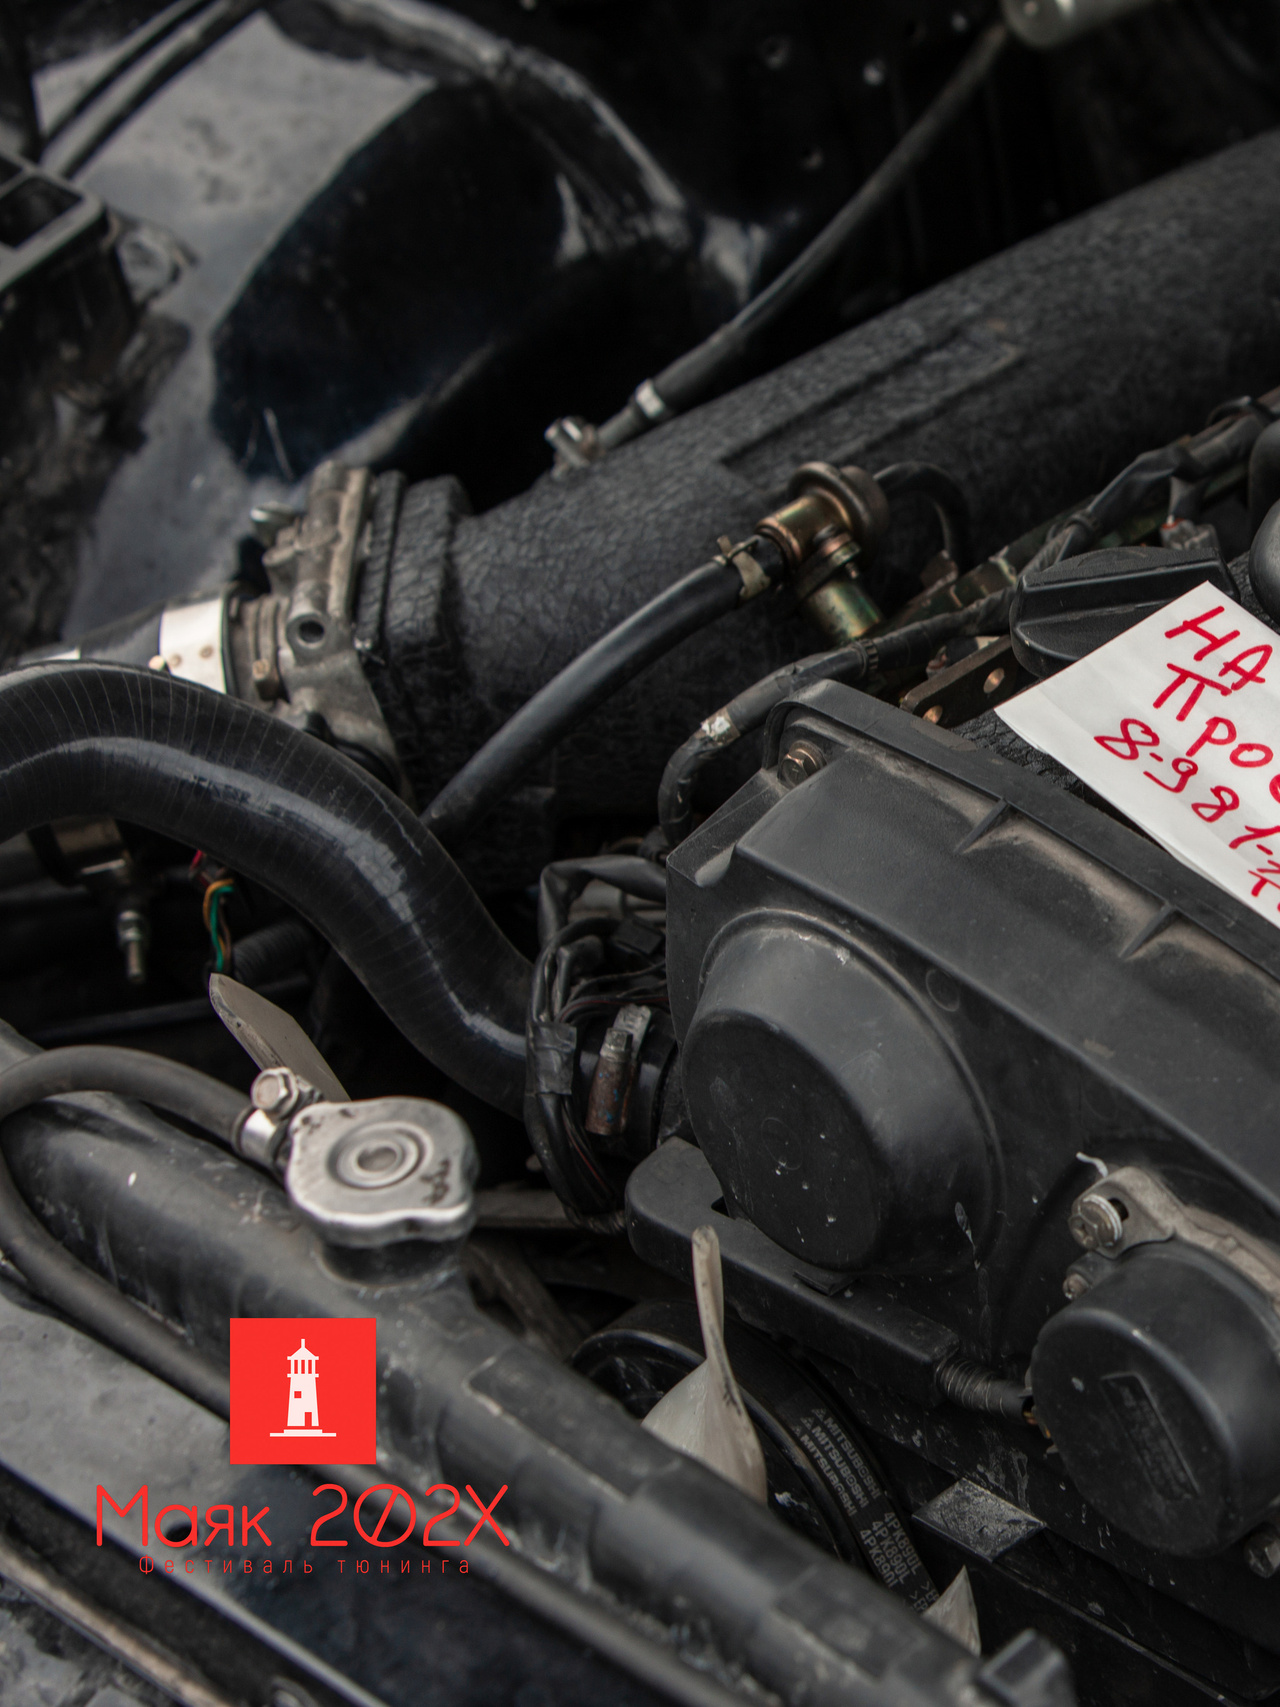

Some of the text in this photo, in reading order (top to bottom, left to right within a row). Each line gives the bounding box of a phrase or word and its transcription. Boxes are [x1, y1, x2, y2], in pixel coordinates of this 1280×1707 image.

[1164, 606, 1274, 691] НА
[811, 1425, 870, 1509] MITSUBOSHI
[872, 1520, 911, 1585] 4PK890L
[823, 1416, 882, 1499] MITSUBOSHI
[884, 1512, 923, 1576] 4PK890L
